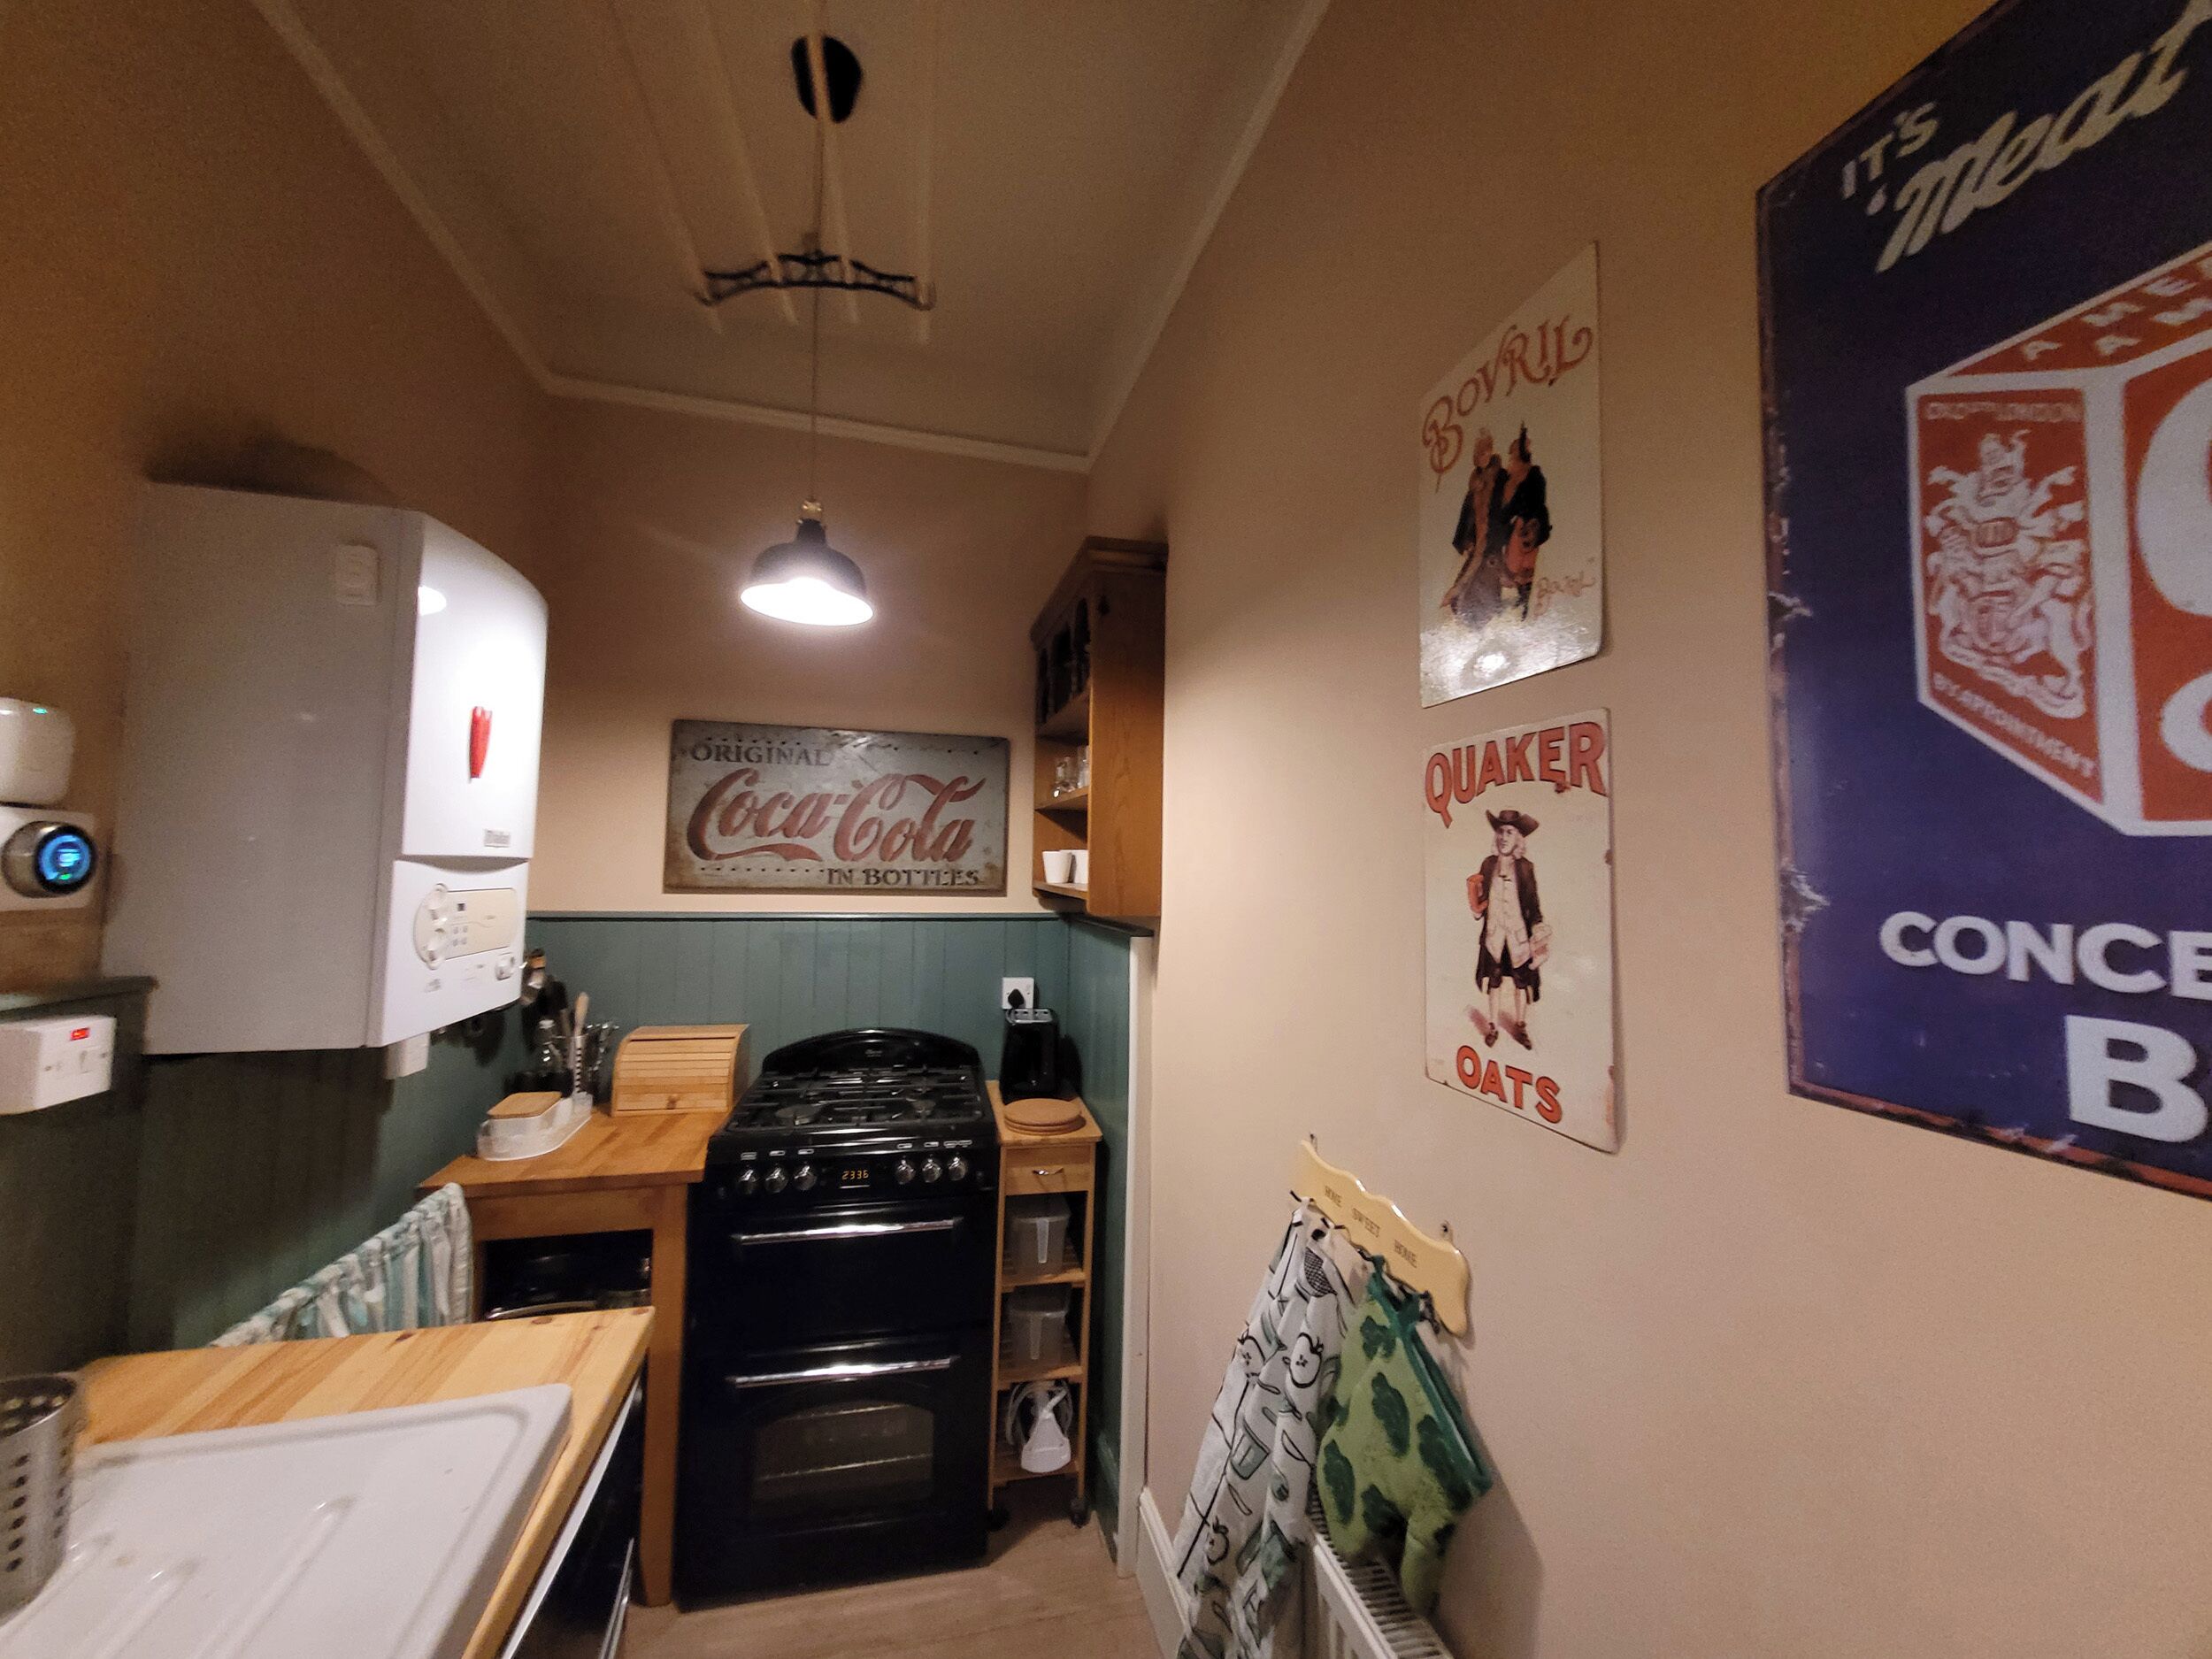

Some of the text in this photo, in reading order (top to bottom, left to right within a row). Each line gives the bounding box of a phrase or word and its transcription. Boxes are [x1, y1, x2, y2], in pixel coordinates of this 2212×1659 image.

[1842, 101, 1939, 200] IT'S
[690, 741, 832, 767] ORIGINAL
[1425, 721, 1607, 828] QUAKER
[686, 766, 987, 863] Coca-Cola
[826, 868, 979, 886] IN BOTTLES
[1455, 1044, 1563, 1124] OATS
[841, 1169, 870, 1180] 2336
